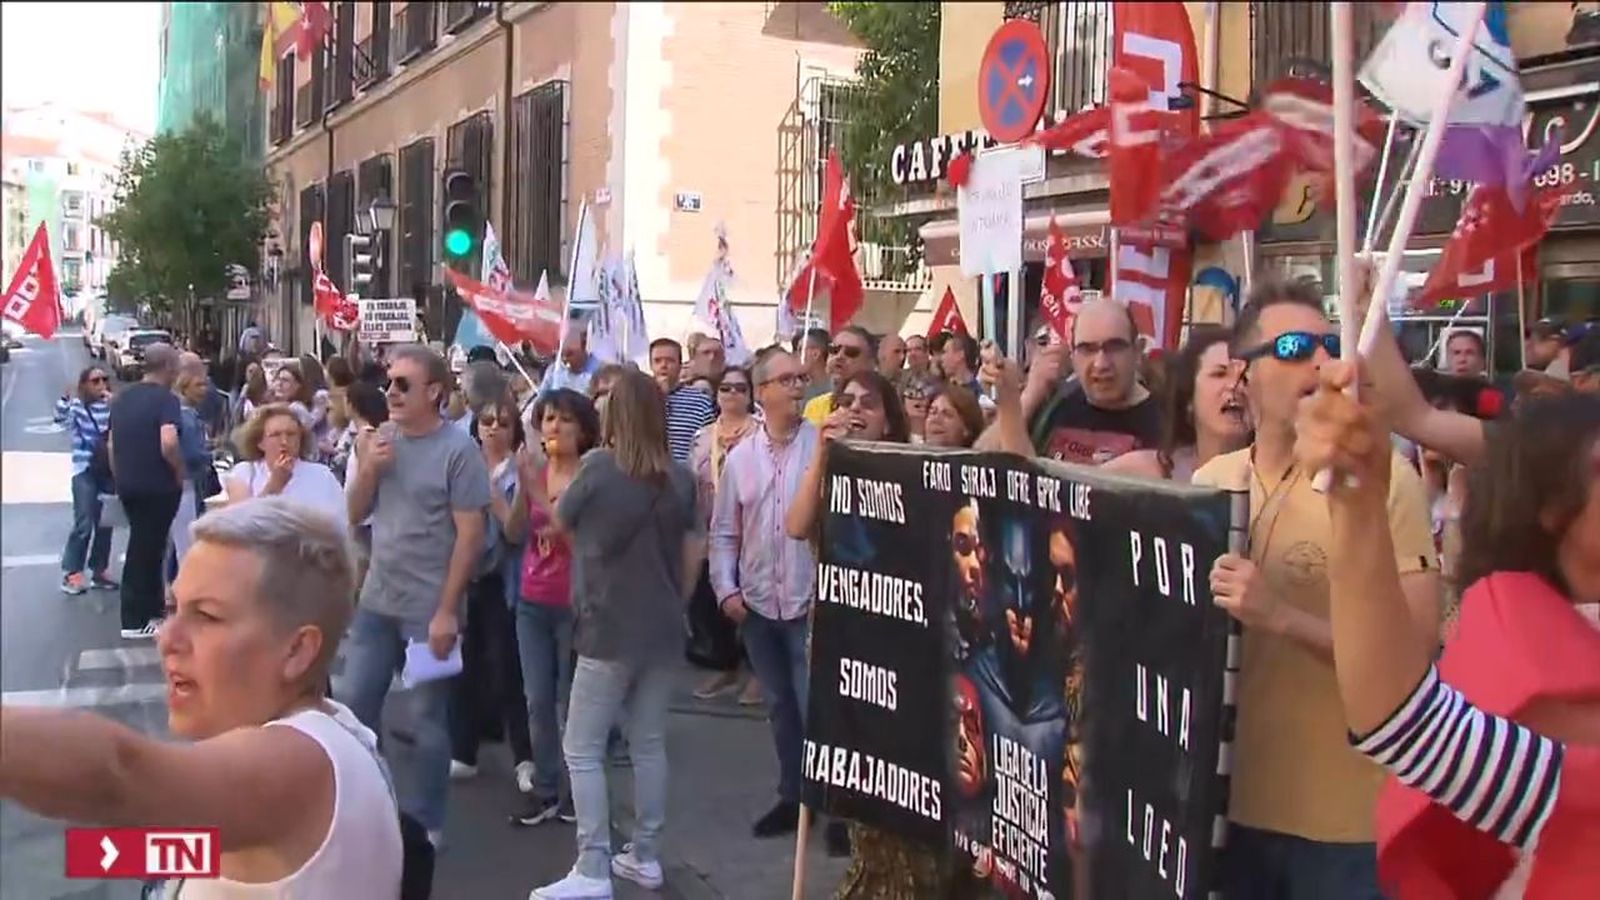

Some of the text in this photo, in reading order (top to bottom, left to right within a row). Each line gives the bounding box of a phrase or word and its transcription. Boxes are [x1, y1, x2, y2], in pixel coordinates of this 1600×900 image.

[830, 475, 905, 524] NO SOMOS
[922, 461, 951, 491] FARO
[961, 465, 996, 497] SIRAJ
[817, 563, 929, 628] VENGADORES,
[1130, 530, 1196, 606] POR
[839, 658, 898, 711] SOMOS
[1136, 663, 1191, 751] UNA
[802, 739, 942, 820] RABAJADORES
[992, 772, 1049, 847] JUSTICIA
[991, 814, 1048, 884] EFICIENTE
